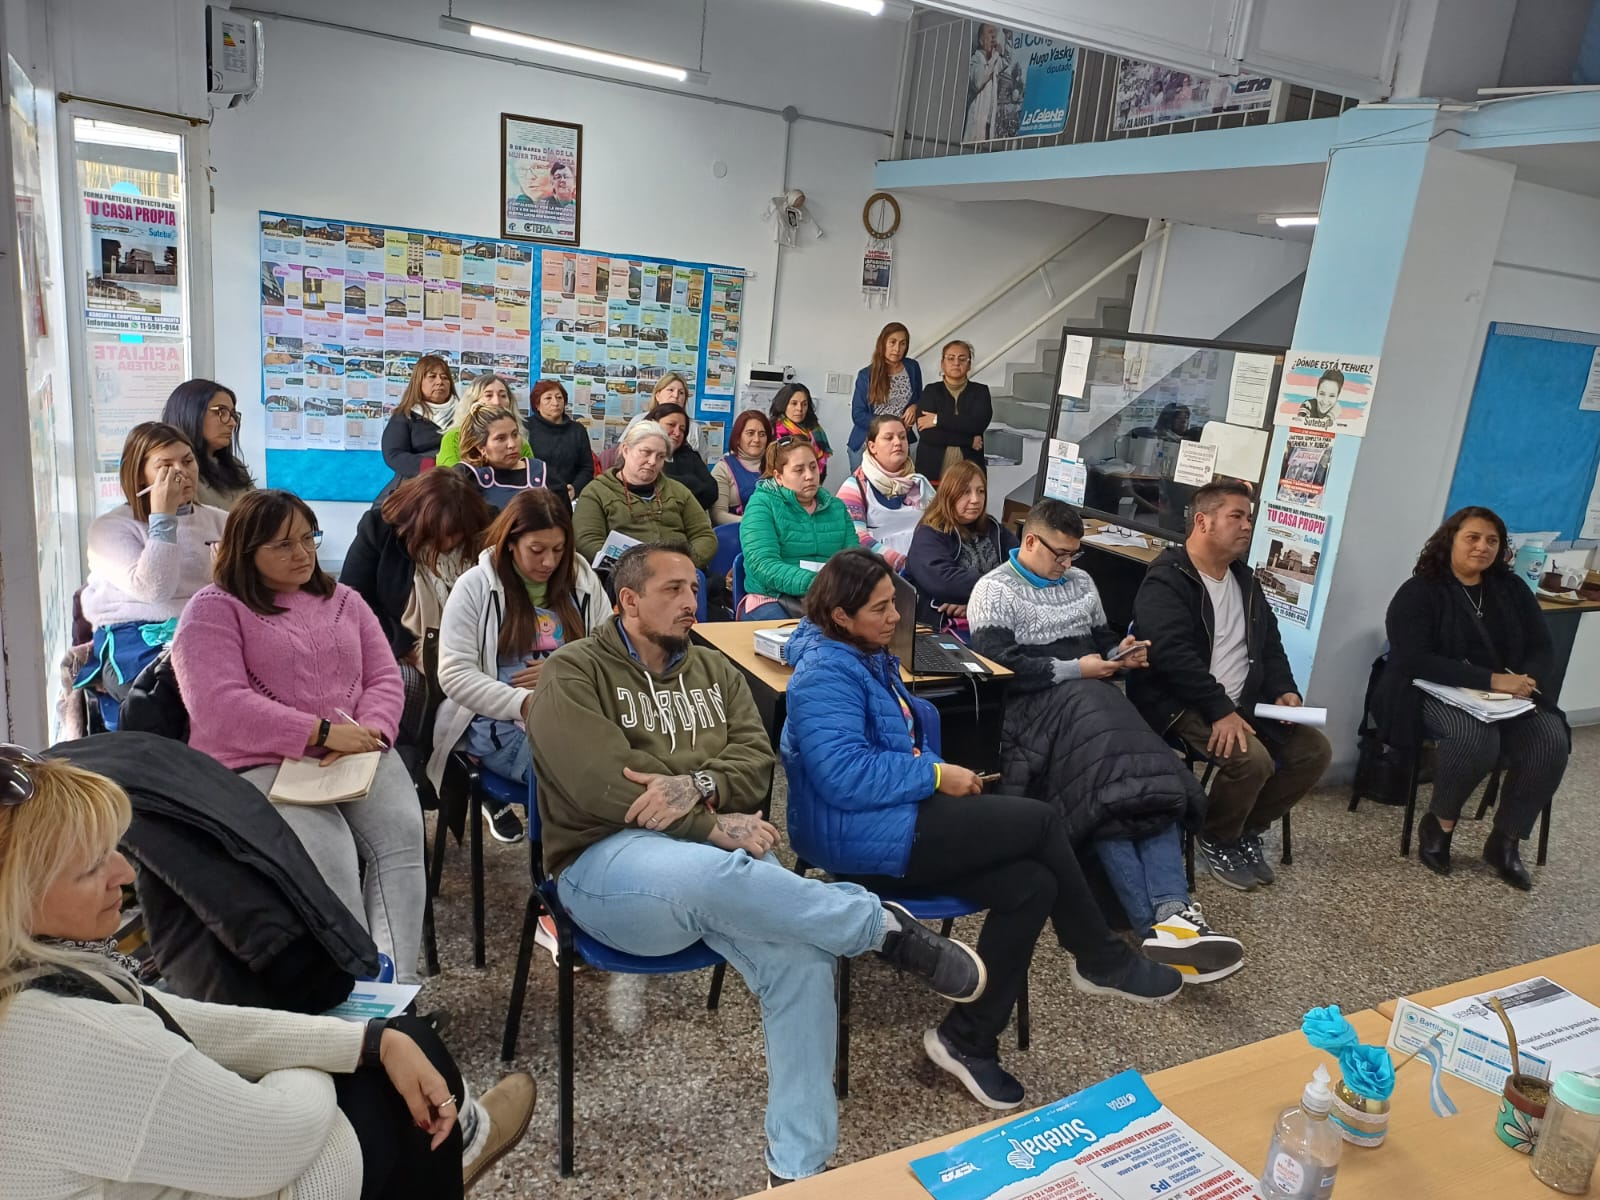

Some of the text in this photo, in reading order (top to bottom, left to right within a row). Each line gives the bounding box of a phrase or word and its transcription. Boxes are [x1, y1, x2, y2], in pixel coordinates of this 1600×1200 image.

[1014, 33, 1023, 49] al
[1029, 46, 1075, 67] Hugo Yasky
[1047, 63, 1072, 74] diputado
[83, 191, 175, 210] FORMA PARTE DEL PROYECTO PARA
[84, 198, 176, 226] TU CASA PROPIA
[524, 223, 553, 234] CTERA
[87, 319, 129, 328] Información
[1291, 356, 1374, 374] ¿DÓNDE ESTÁ TEHUEL?
[1267, 509, 1277, 522] TU
[1278, 511, 1298, 528] CASA
[616, 682, 727, 734] JORDAN
[1531, 1041, 1554, 1051] Buenos
[1147, 1121, 1171, 1133] RECHAZO
[1021, 1118, 1098, 1157] Suteba
[1151, 1178, 1171, 1192] IPS
[1199, 1169, 1234, 1188] DEFENDAMOS
